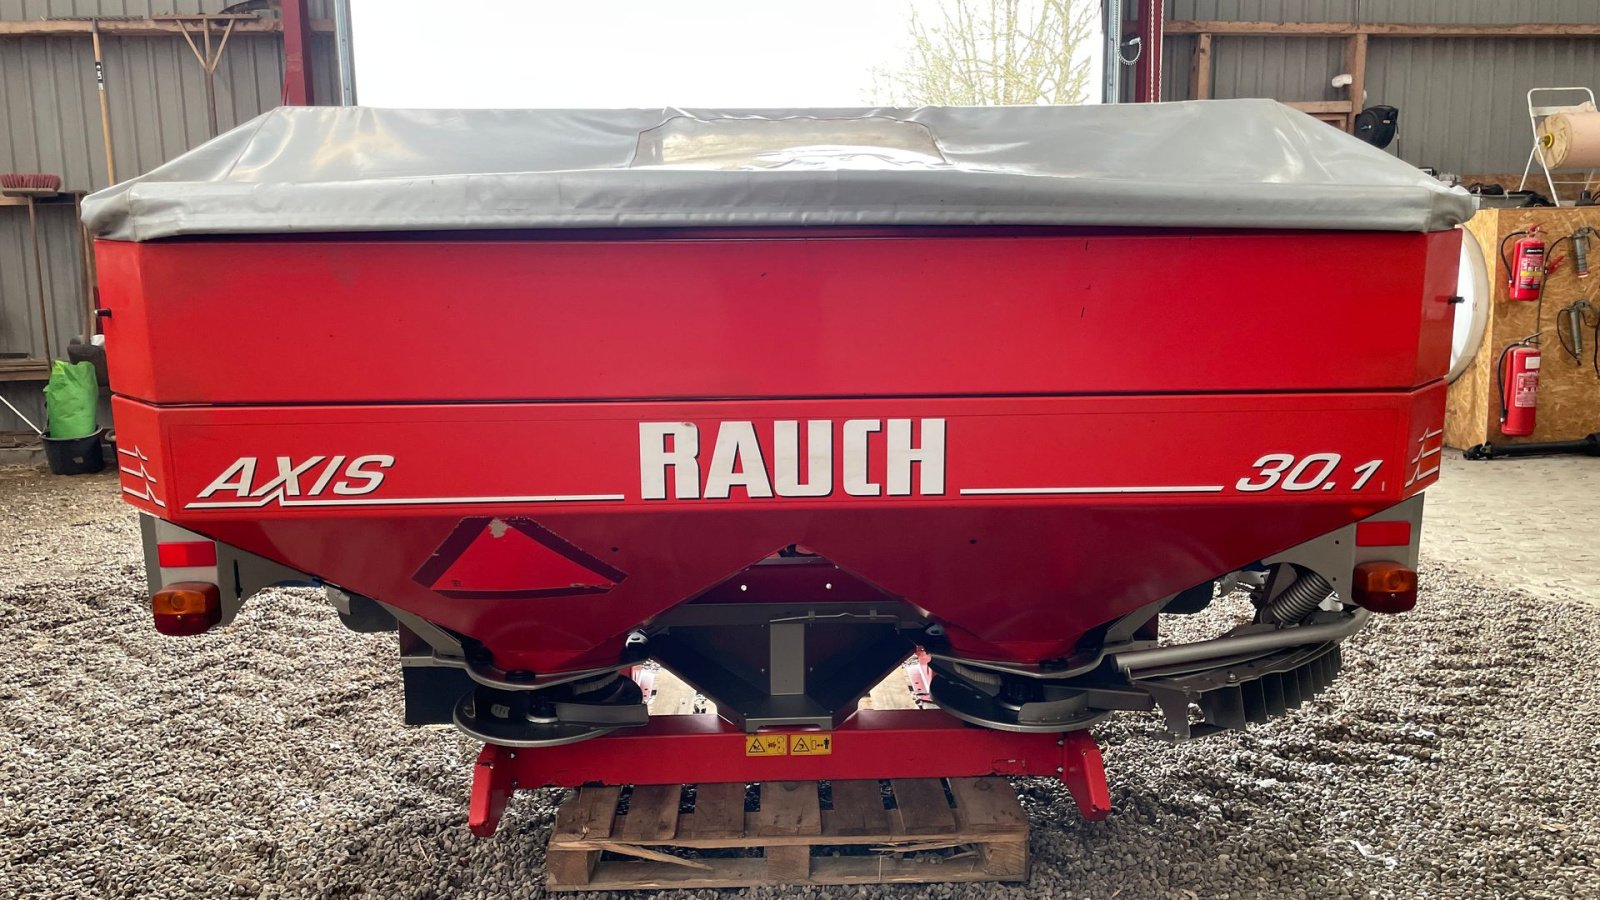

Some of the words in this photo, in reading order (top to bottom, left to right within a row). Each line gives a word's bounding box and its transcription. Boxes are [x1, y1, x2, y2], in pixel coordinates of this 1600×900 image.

[196, 454, 395, 499] AXIS
[638, 417, 947, 501] RAUCH
[1234, 452, 1384, 492] 30.1
